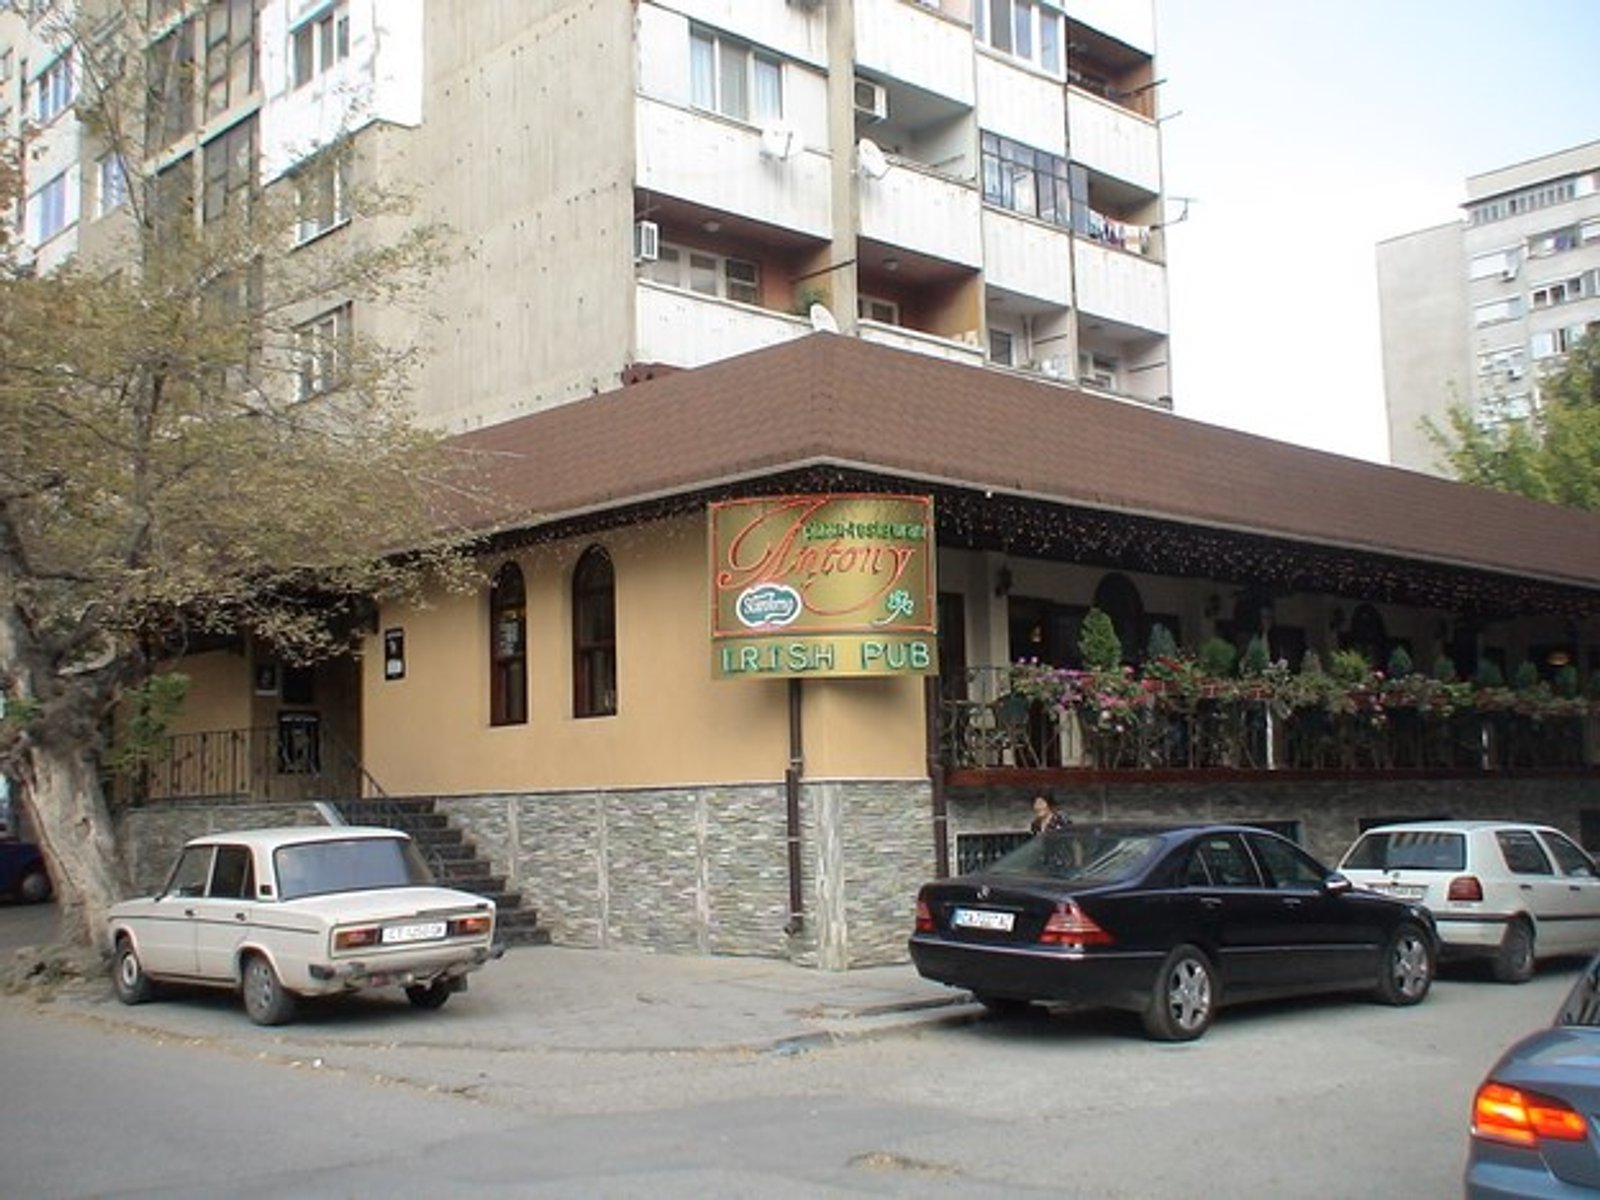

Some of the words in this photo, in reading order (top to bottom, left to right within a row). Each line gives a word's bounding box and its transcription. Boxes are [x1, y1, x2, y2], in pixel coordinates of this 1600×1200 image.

[717, 495, 915, 616] Antony
[722, 642, 834, 673] IRISH
[861, 640, 930, 669] PUB
